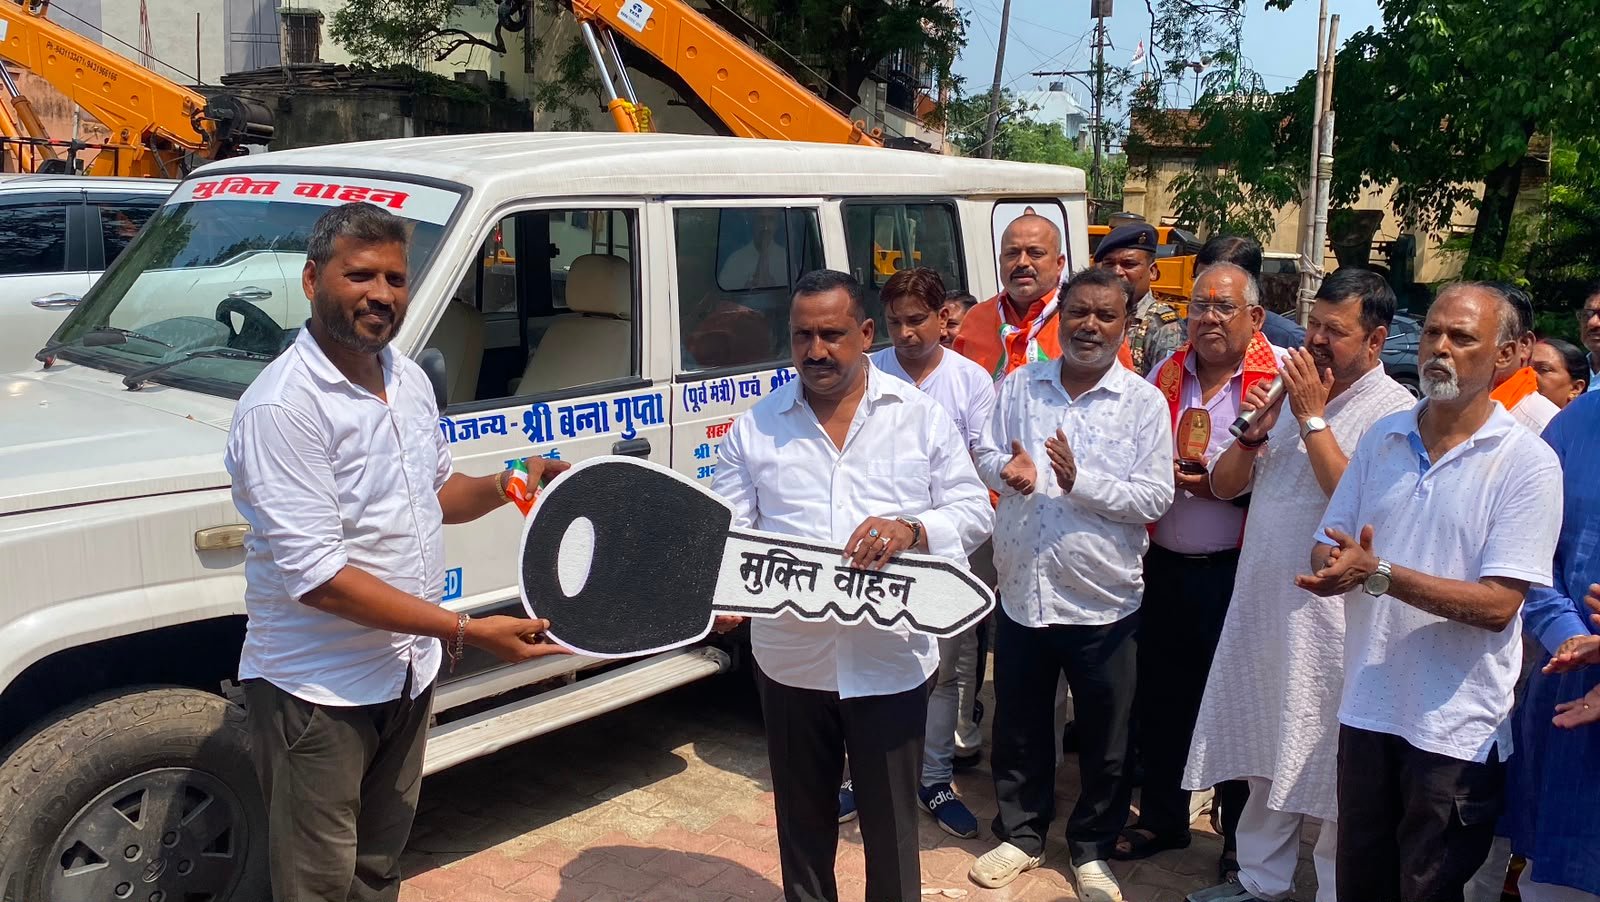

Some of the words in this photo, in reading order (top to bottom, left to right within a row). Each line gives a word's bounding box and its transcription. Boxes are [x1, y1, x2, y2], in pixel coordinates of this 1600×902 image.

[192, 177, 281, 199] मुक्ति
[293, 182, 411, 209] वाहन
[522, 402, 555, 443] श्री
[558, 401, 610, 438] बन्ना
[614, 393, 664, 440] गुप्ता
[683, 382, 708, 412] (पूर्व
[710, 378, 736, 405] मंत्री)
[738, 375, 762, 398] एवं
[694, 443, 710, 459] श्री
[740, 549, 823, 595] मुक्ति
[834, 565, 916, 606] वाहन
